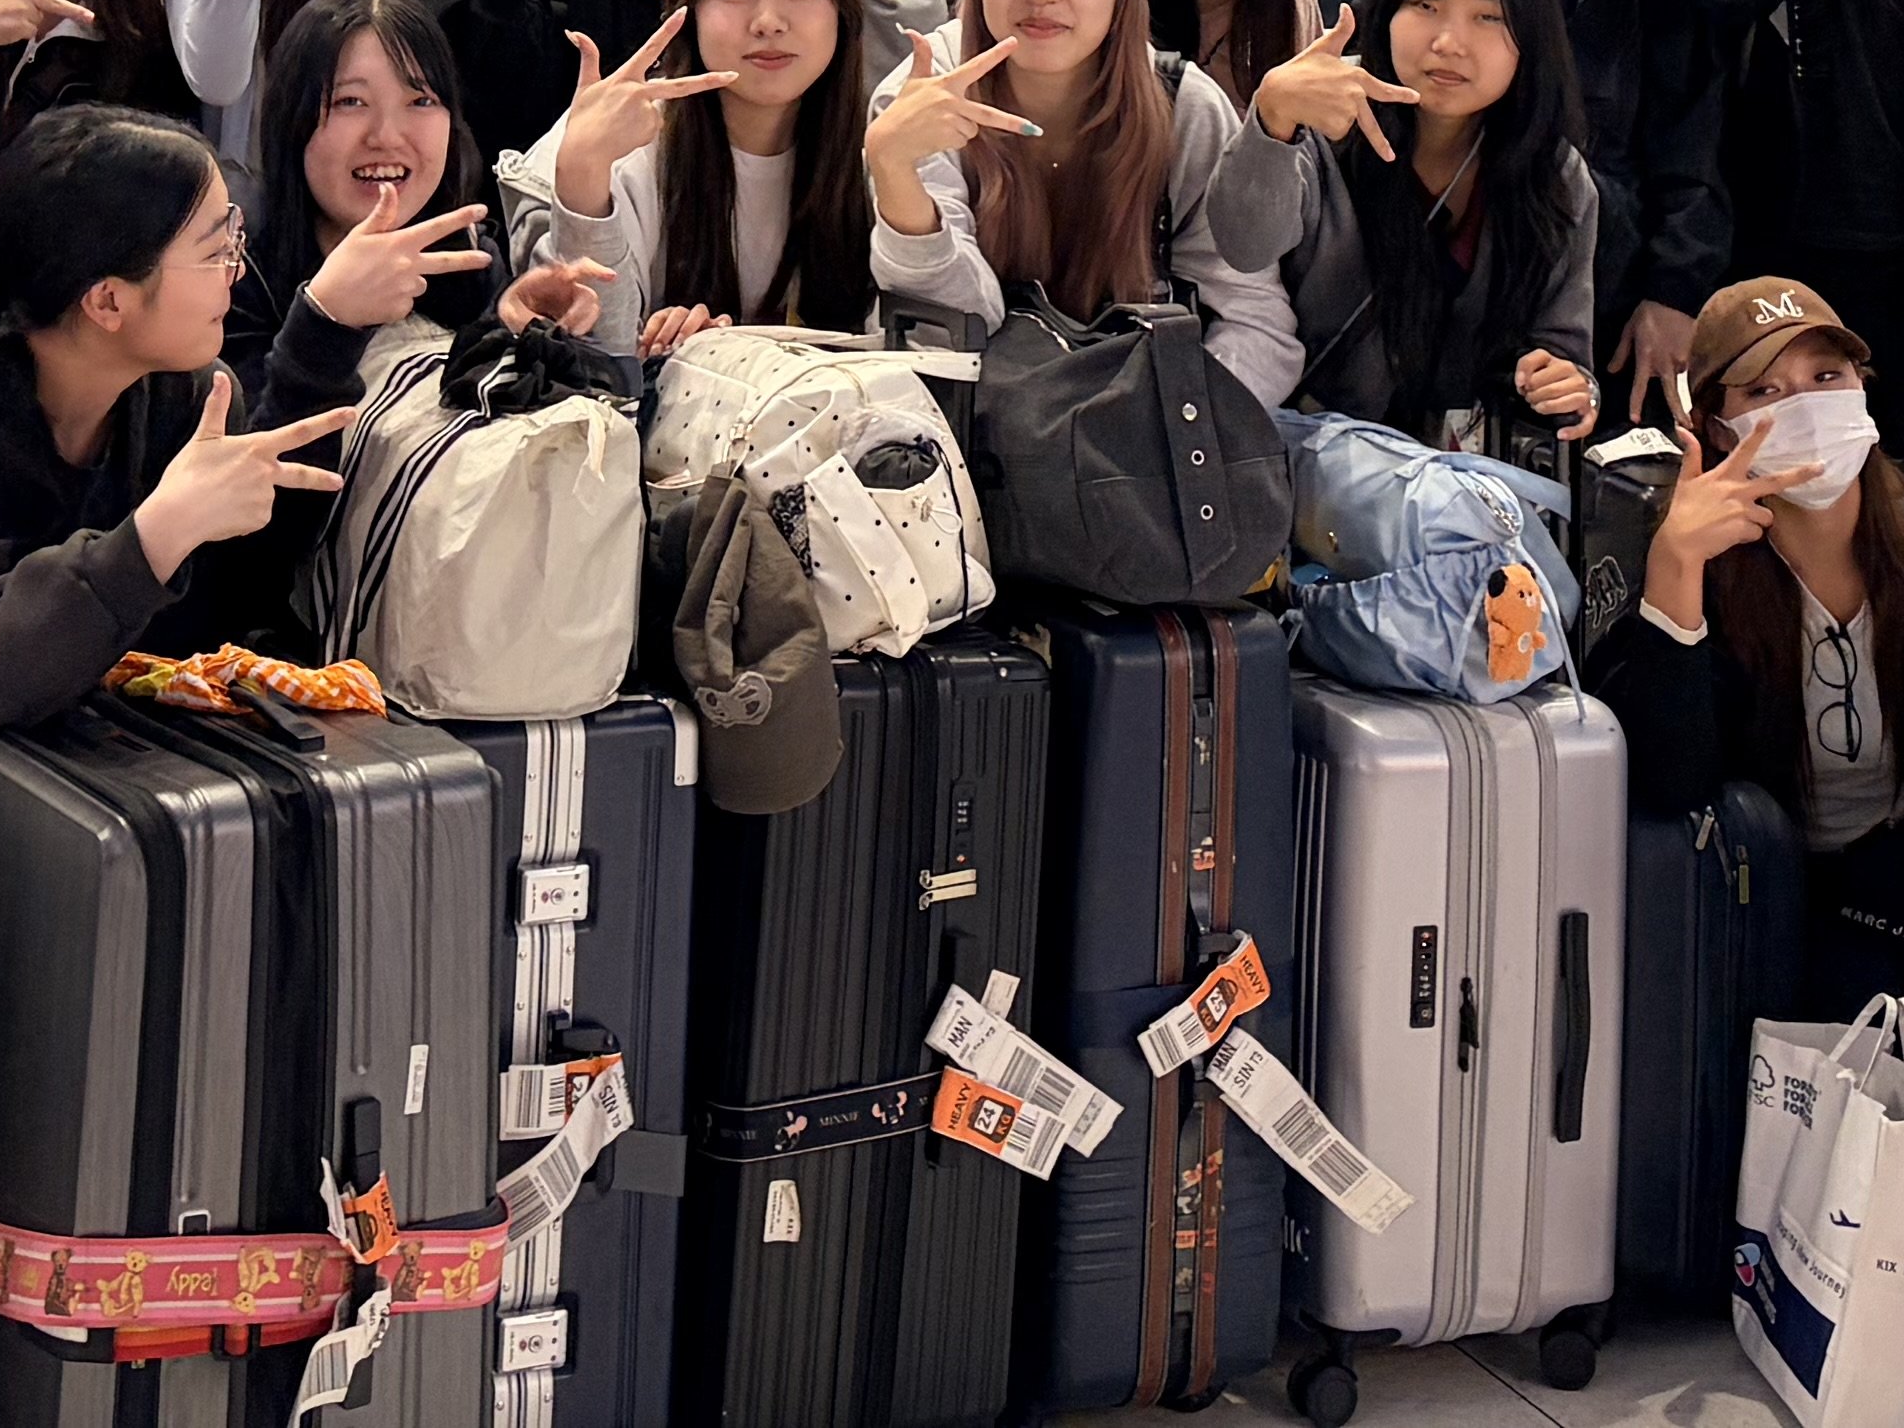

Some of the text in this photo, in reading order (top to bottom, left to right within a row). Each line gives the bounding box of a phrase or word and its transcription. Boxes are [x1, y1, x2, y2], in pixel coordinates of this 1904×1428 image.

[1239, 955, 1266, 995] HEAVY
[1209, 994, 1226, 1013] 25
[948, 1015, 973, 1048] MAN
[1212, 1041, 1238, 1072] MAN
[1233, 1061, 1256, 1089] SIN
[598, 1084, 619, 1115] SIN
[948, 1082, 972, 1131] HEAVY
[976, 1105, 996, 1130] 24
[1876, 1258, 1897, 1273] KIX
